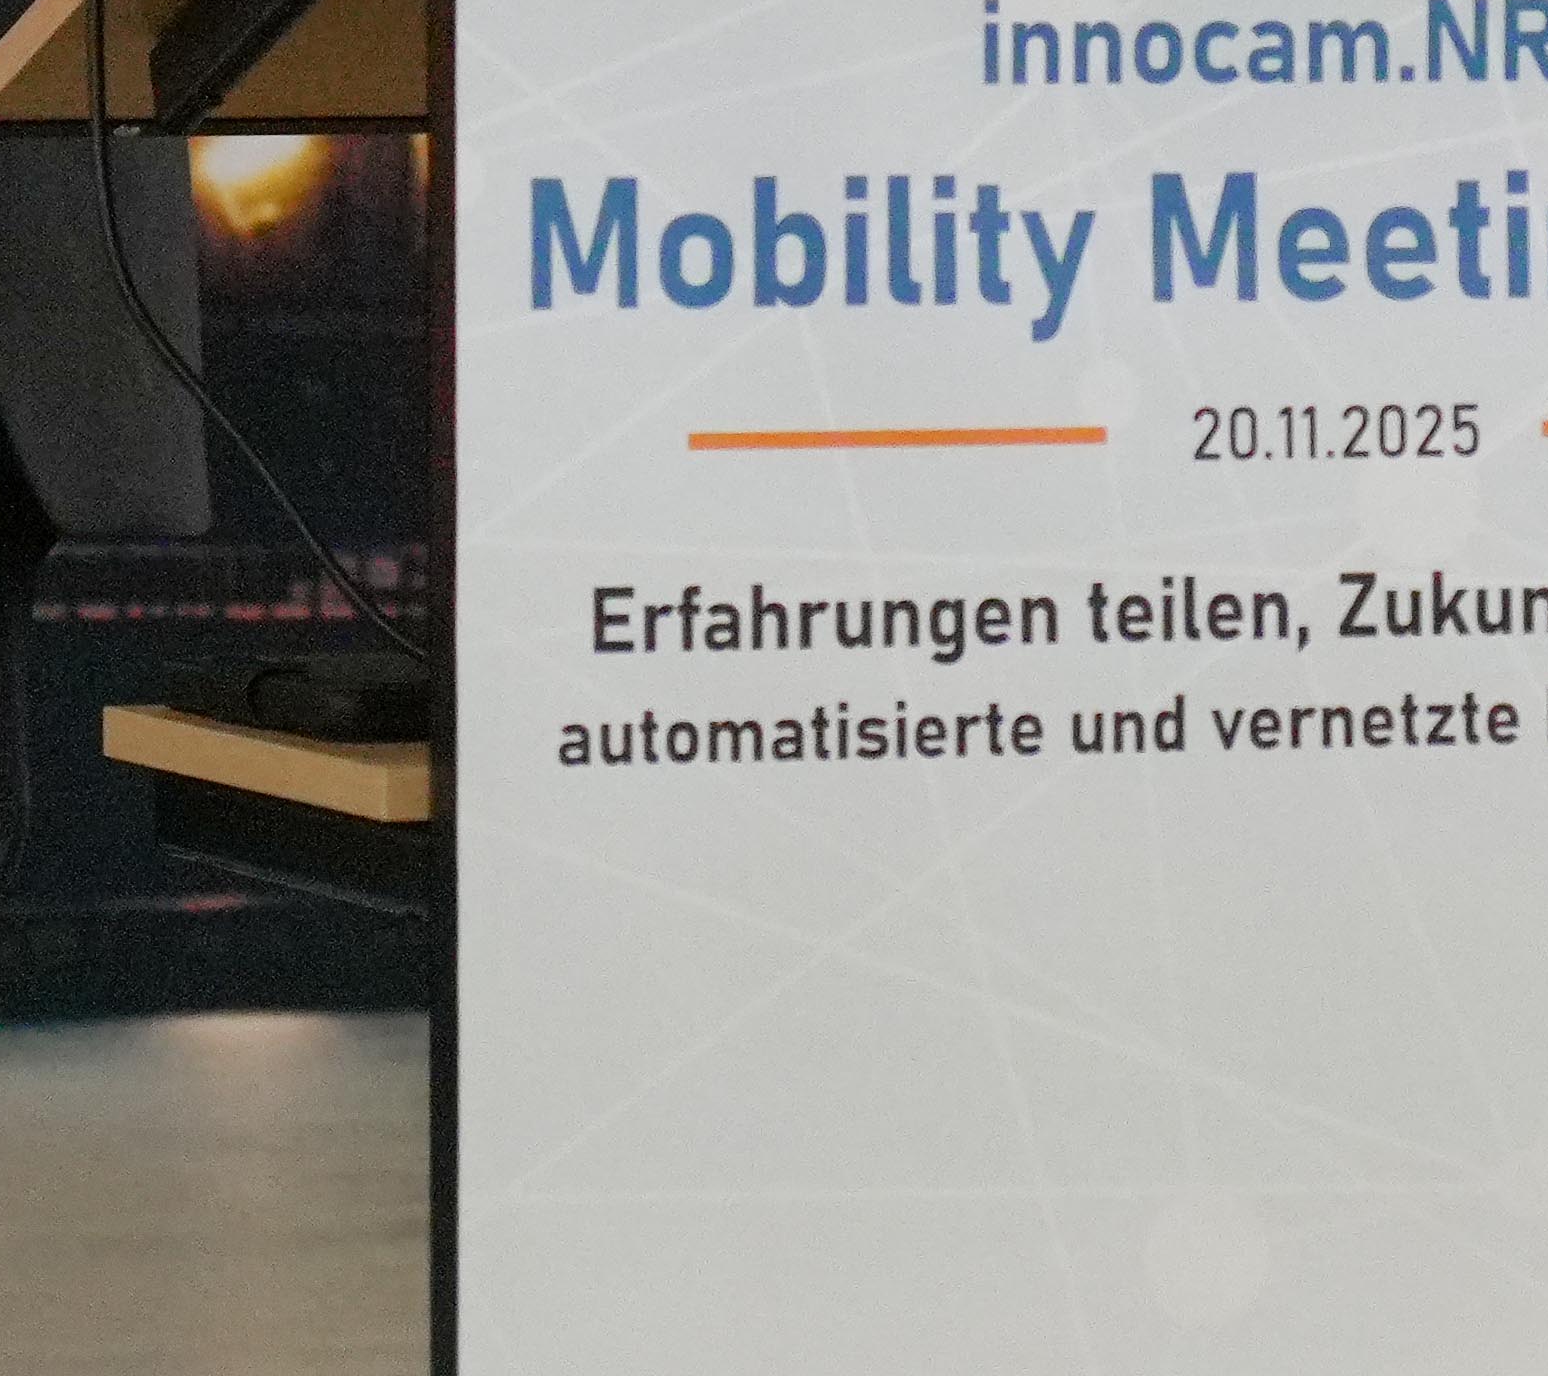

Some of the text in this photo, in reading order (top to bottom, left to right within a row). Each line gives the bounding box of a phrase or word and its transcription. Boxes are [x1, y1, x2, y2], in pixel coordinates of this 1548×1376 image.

[531, 175, 1095, 342] Mobility
[1193, 403, 1479, 460] 20.11.2025
[594, 584, 1057, 664] Erfahrungen
[1088, 576, 1309, 649] teilen,
[559, 701, 1043, 766] automatisierte
[1072, 694, 1185, 753] und
[1212, 692, 1518, 750] vernetzte
